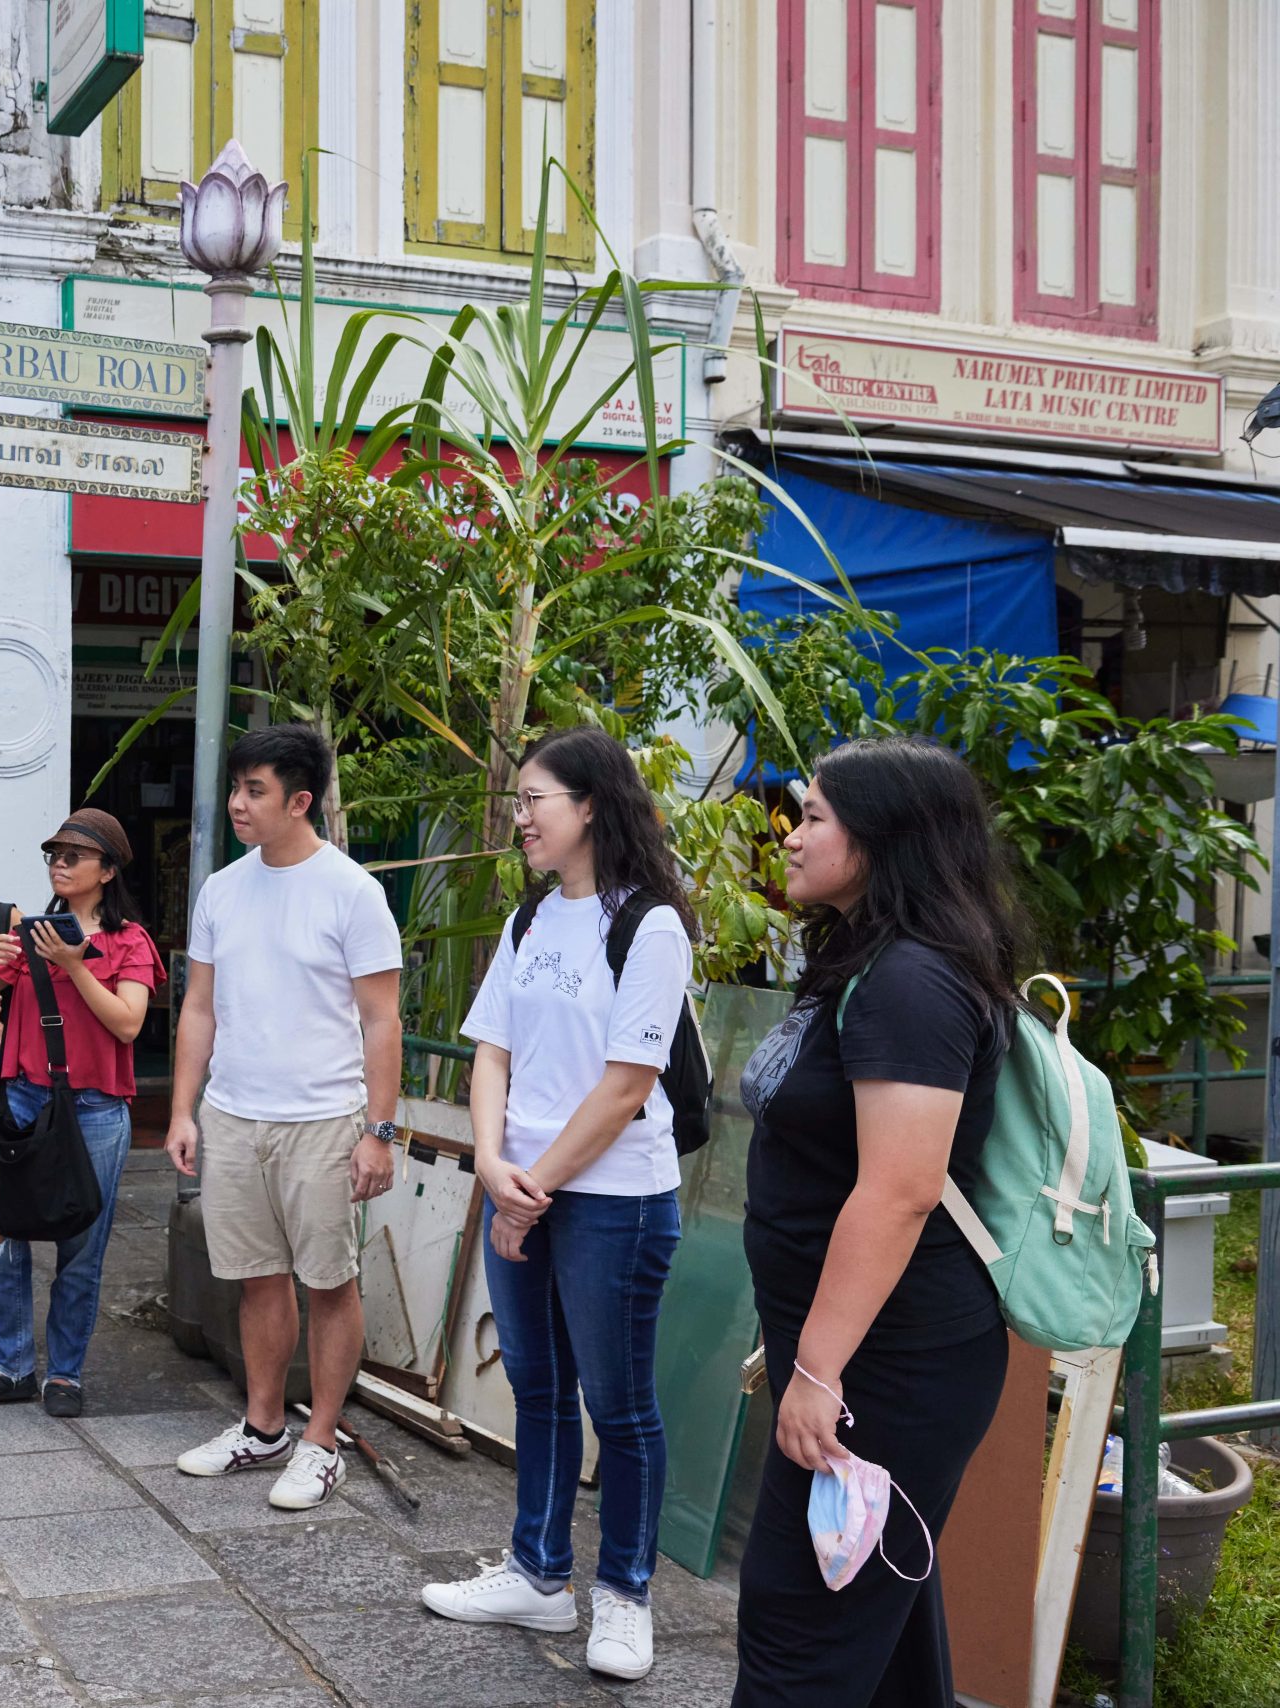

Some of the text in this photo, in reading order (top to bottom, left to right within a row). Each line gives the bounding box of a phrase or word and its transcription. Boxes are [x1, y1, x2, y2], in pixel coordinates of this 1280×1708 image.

[85, 304, 113, 313] DIGITAL
[88, 297, 121, 306] FUJIFILM
[83, 312, 116, 321] IMAGING
[97, 354, 187, 397] ROAD
[953, 358, 1208, 405] NARUMEX PRIVATE LIMITED
[819, 375, 933, 402] MUSIC CENTRE
[984, 388, 1180, 427] LATA MUSIC CENTRE
[602, 412, 637, 423] DIGITAL
